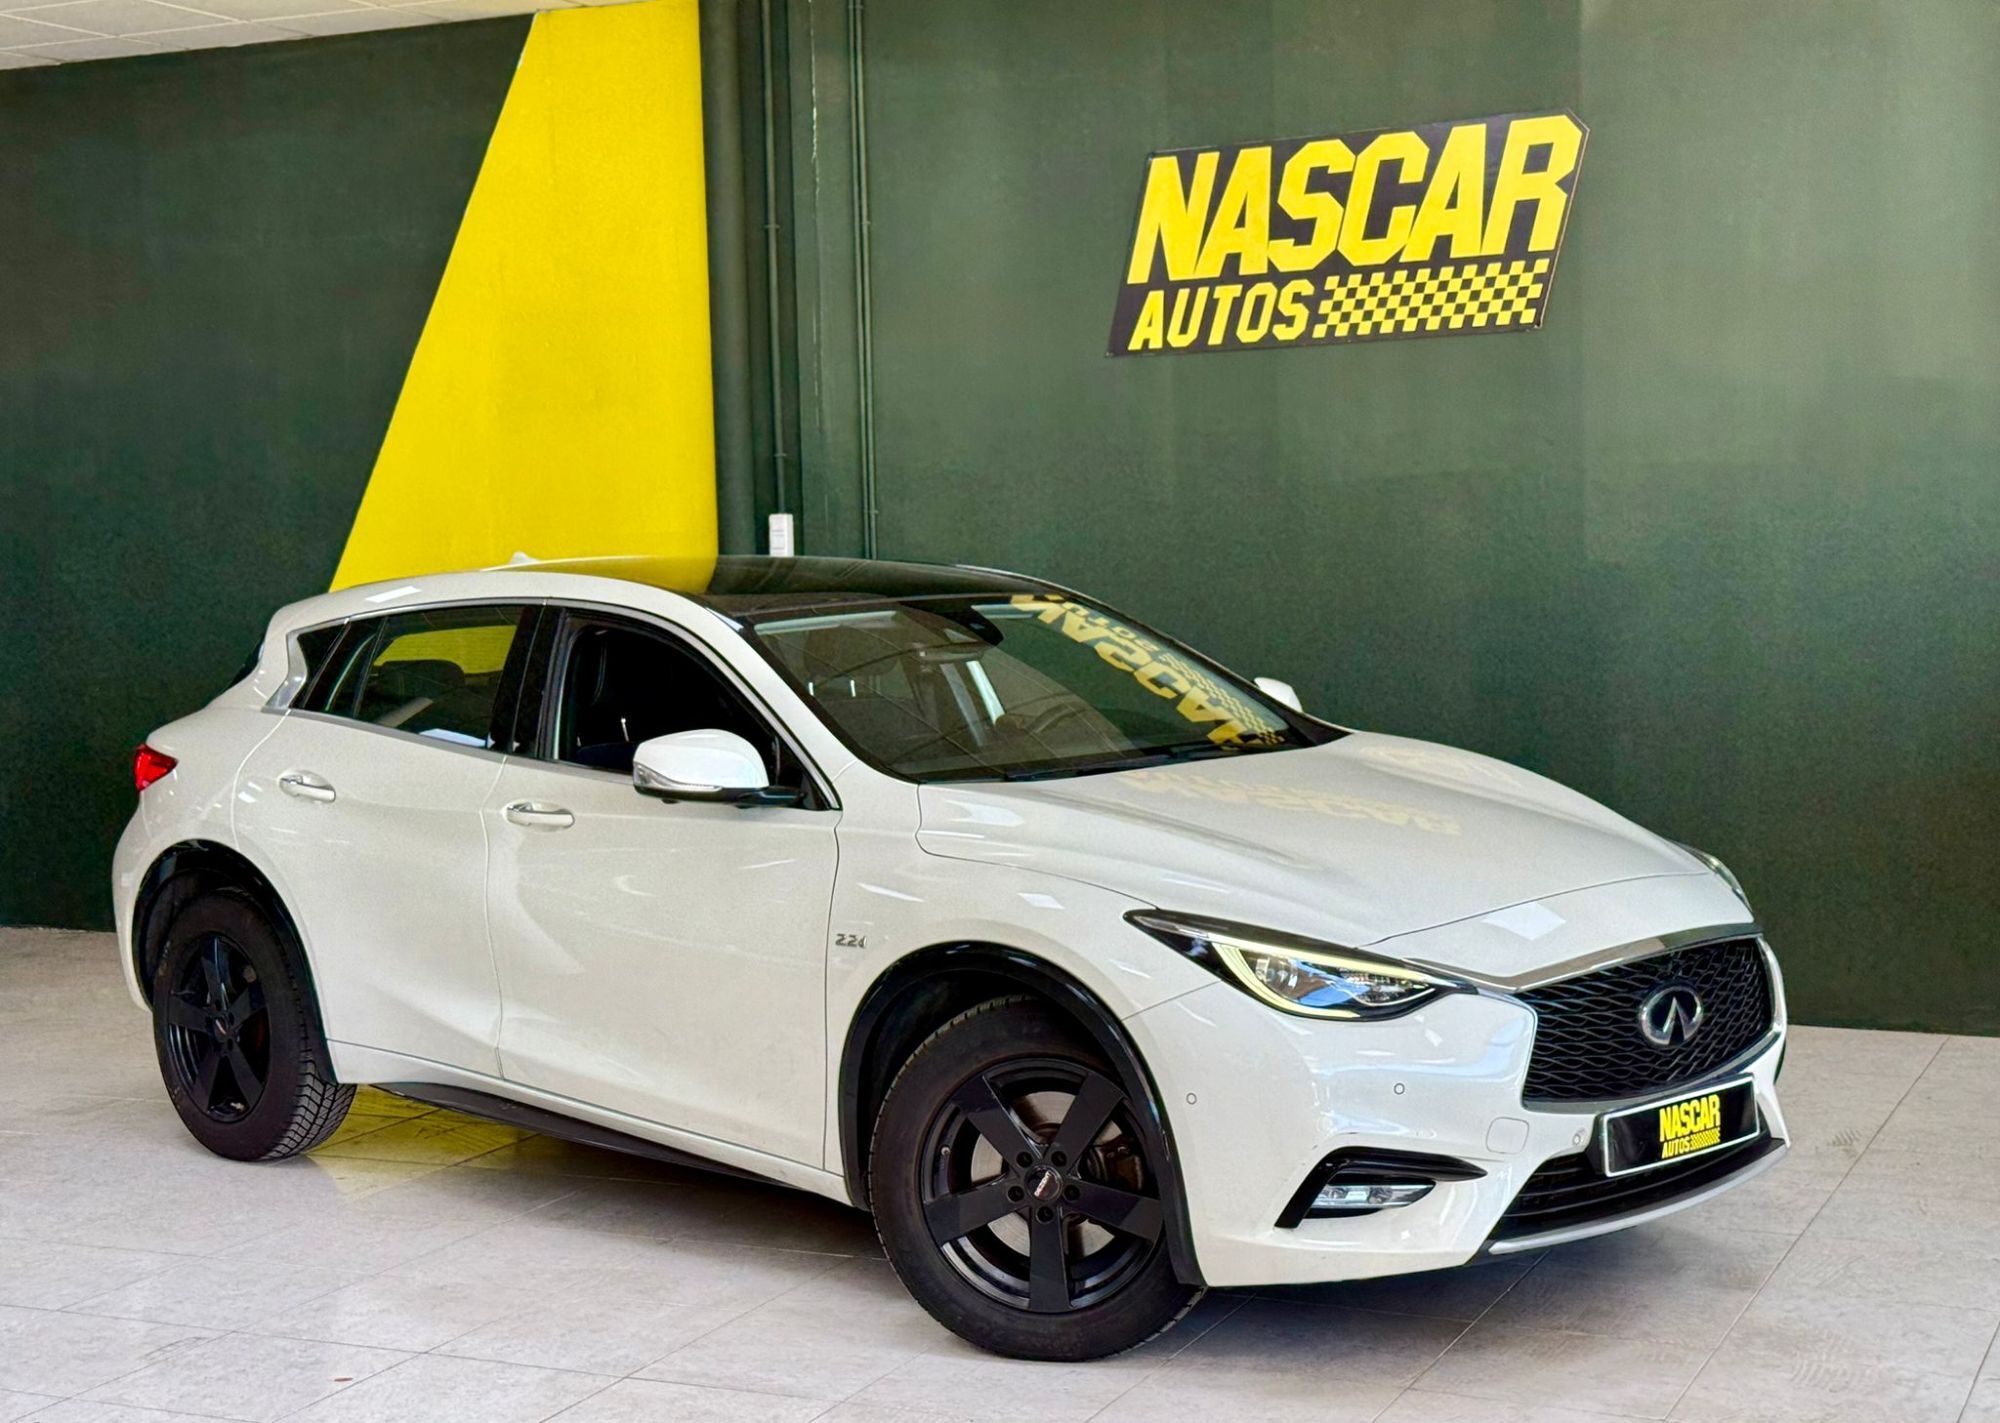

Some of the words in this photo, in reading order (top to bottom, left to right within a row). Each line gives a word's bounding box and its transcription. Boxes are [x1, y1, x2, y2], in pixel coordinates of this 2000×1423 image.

[1127, 114, 1583, 284] NASCAR
[1127, 279, 1315, 350] AUTOS
[1659, 1094, 1720, 1142] NASCAR
[1661, 1136, 1690, 1159] AUTOS
